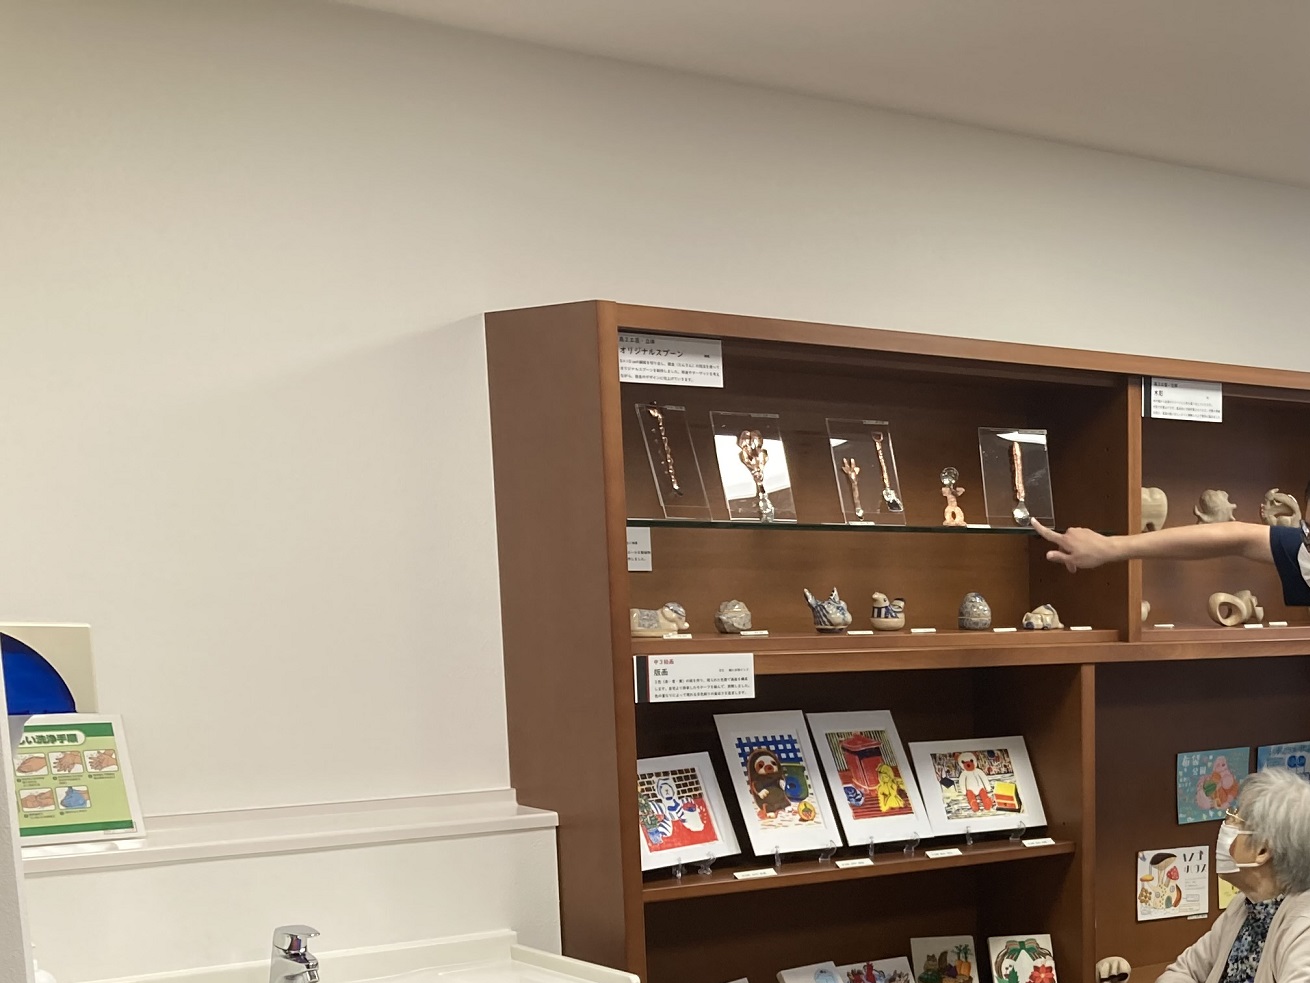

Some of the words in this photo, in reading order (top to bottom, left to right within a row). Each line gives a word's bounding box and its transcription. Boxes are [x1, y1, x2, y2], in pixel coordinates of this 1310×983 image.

[619, 346, 684, 358] オリジナルスプーン
[654, 668, 668, 676] 版画
